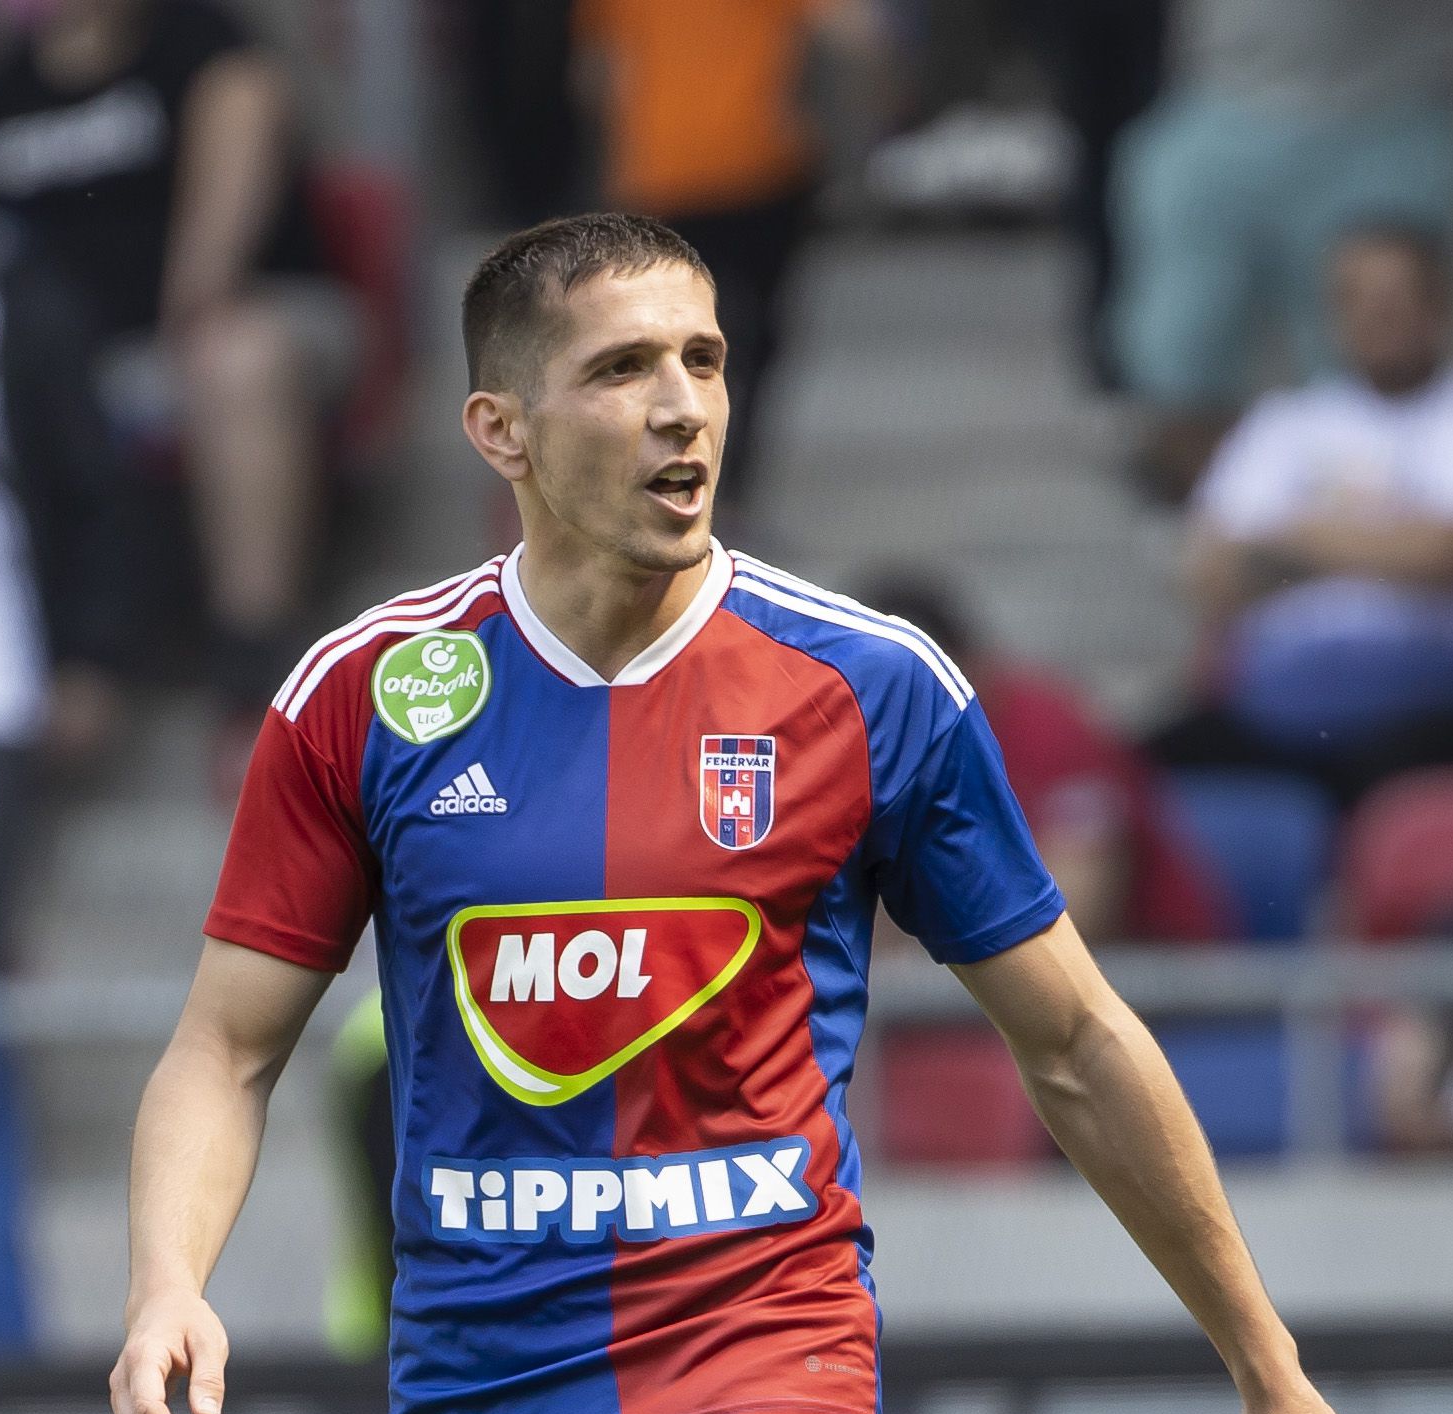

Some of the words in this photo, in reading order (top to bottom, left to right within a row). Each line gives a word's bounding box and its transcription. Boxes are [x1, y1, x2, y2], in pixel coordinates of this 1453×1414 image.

[383, 664, 480, 701] otpbank
[705, 755, 769, 768] FEHÉRVÁR
[430, 794, 508, 815] adidas
[490, 928, 652, 1002] MOL
